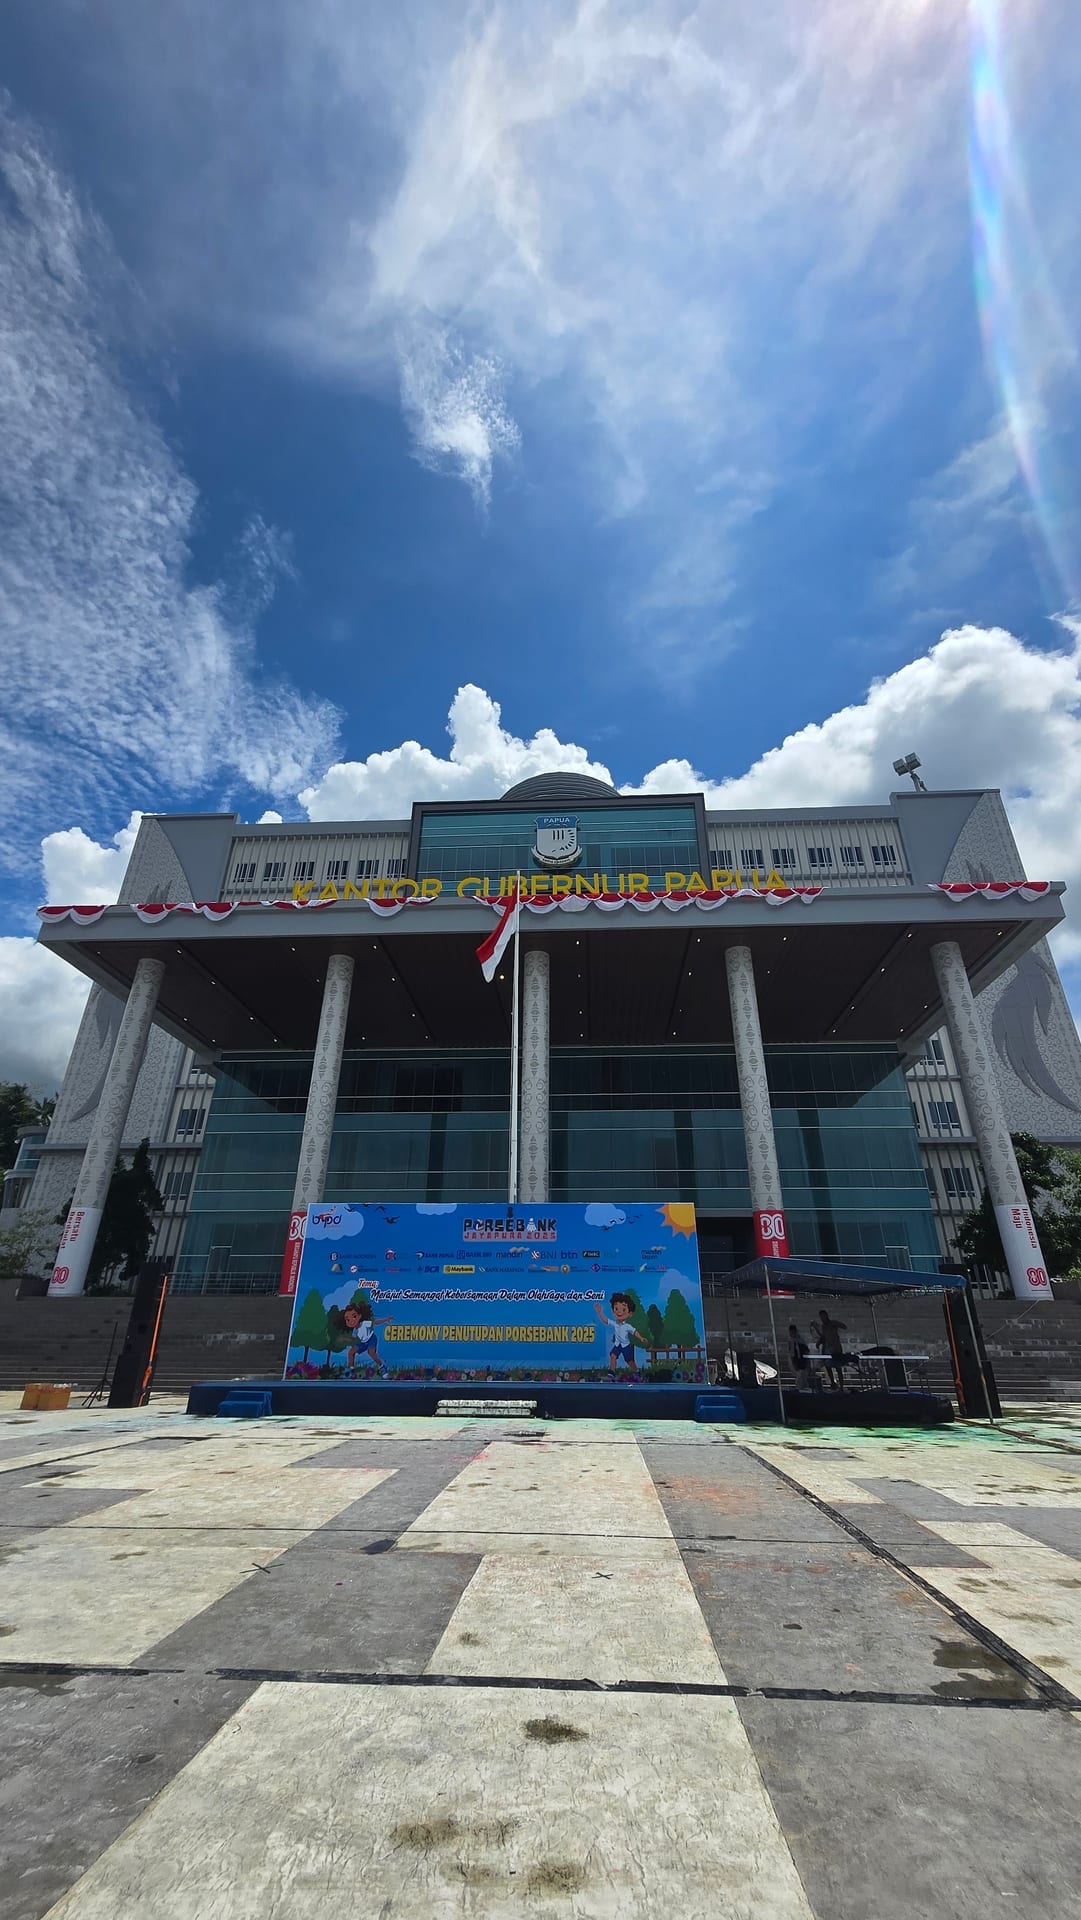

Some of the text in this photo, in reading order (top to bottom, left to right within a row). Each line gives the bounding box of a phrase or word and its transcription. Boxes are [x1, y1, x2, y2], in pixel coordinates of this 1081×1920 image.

[292, 869, 786, 901] KANTOR GUBERNUR PAPUA
[70, 1211, 85, 1242] Bersatu
[1011, 1208, 1023, 1229] Maju
[526, 1231, 556, 1239] 2025
[1022, 1208, 1038, 1249] Indonesia
[541, 1251, 556, 1259] BNI
[561, 1251, 577, 1259] btn
[371, 1289, 605, 1302] Merajut Semangat Kebersamaan Dalam Olahraga dan Seni
[384, 1325, 595, 1342] CEREMONY PENUTUPAN PORSEBANK 2025
